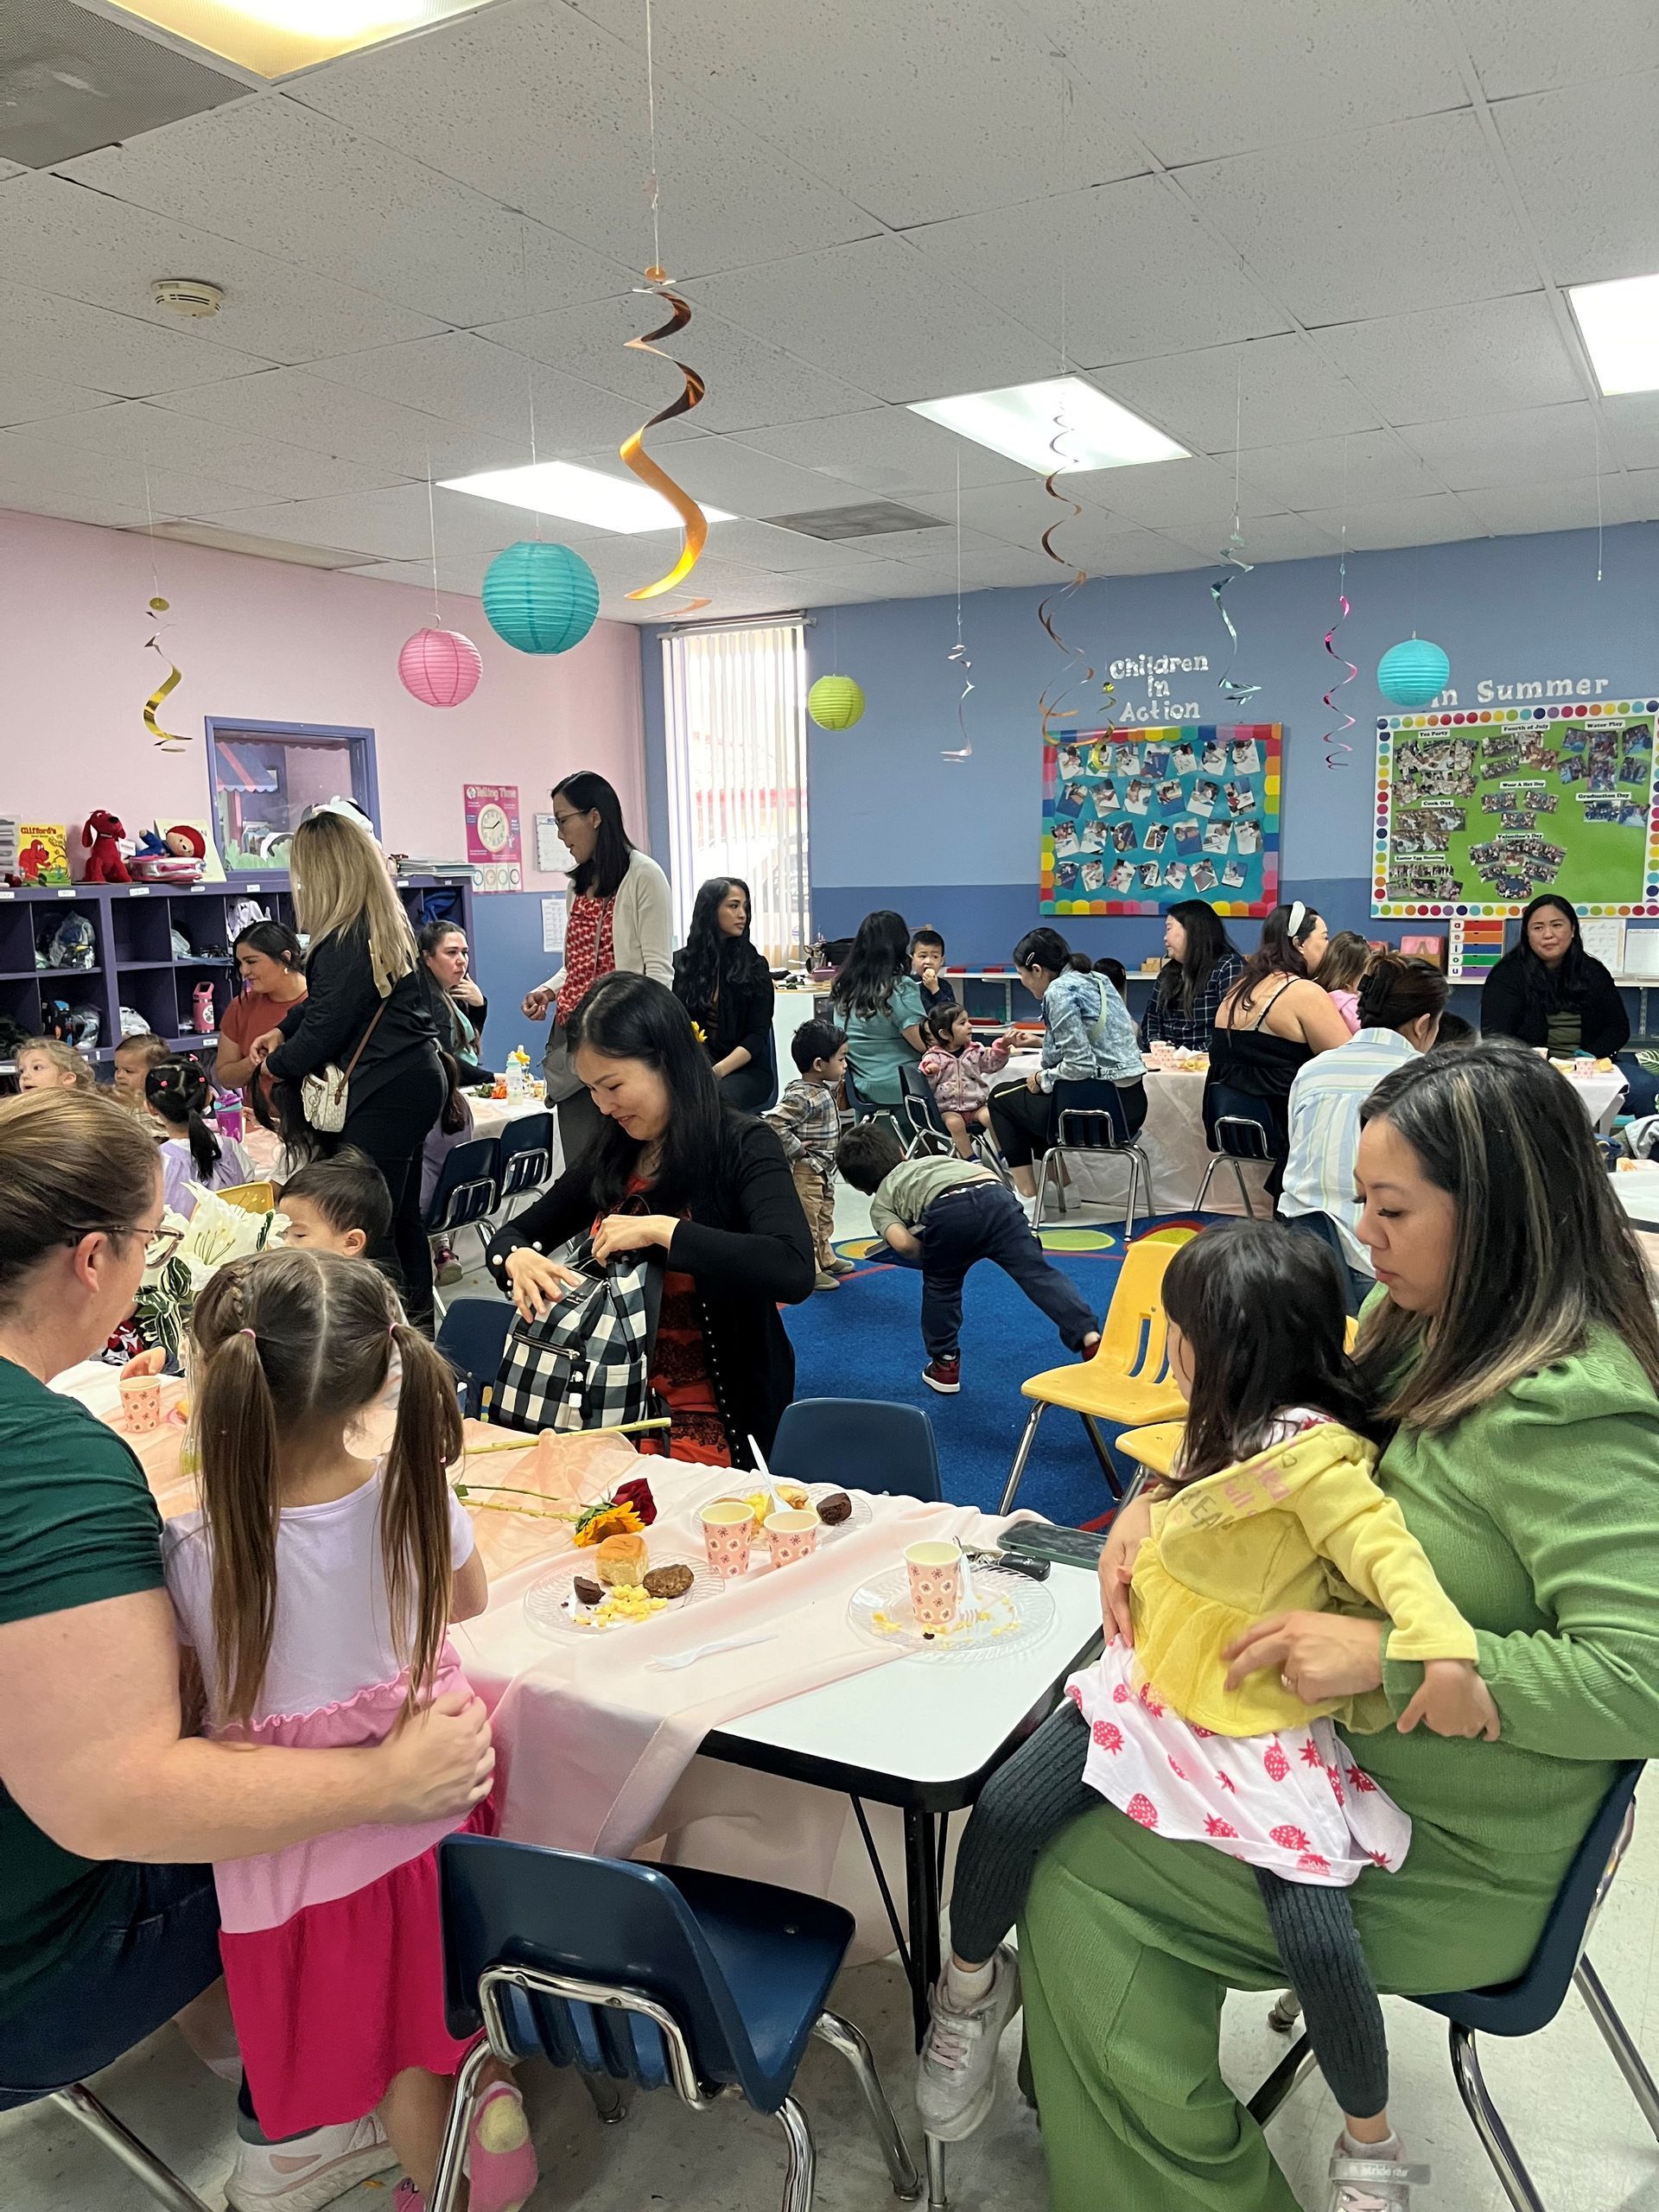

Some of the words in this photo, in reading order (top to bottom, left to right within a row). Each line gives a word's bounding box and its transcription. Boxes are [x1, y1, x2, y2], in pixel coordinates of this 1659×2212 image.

[1109, 654, 1210, 680] Children
[1476, 677, 1609, 703] Summer
[1119, 700, 1201, 722] Action
